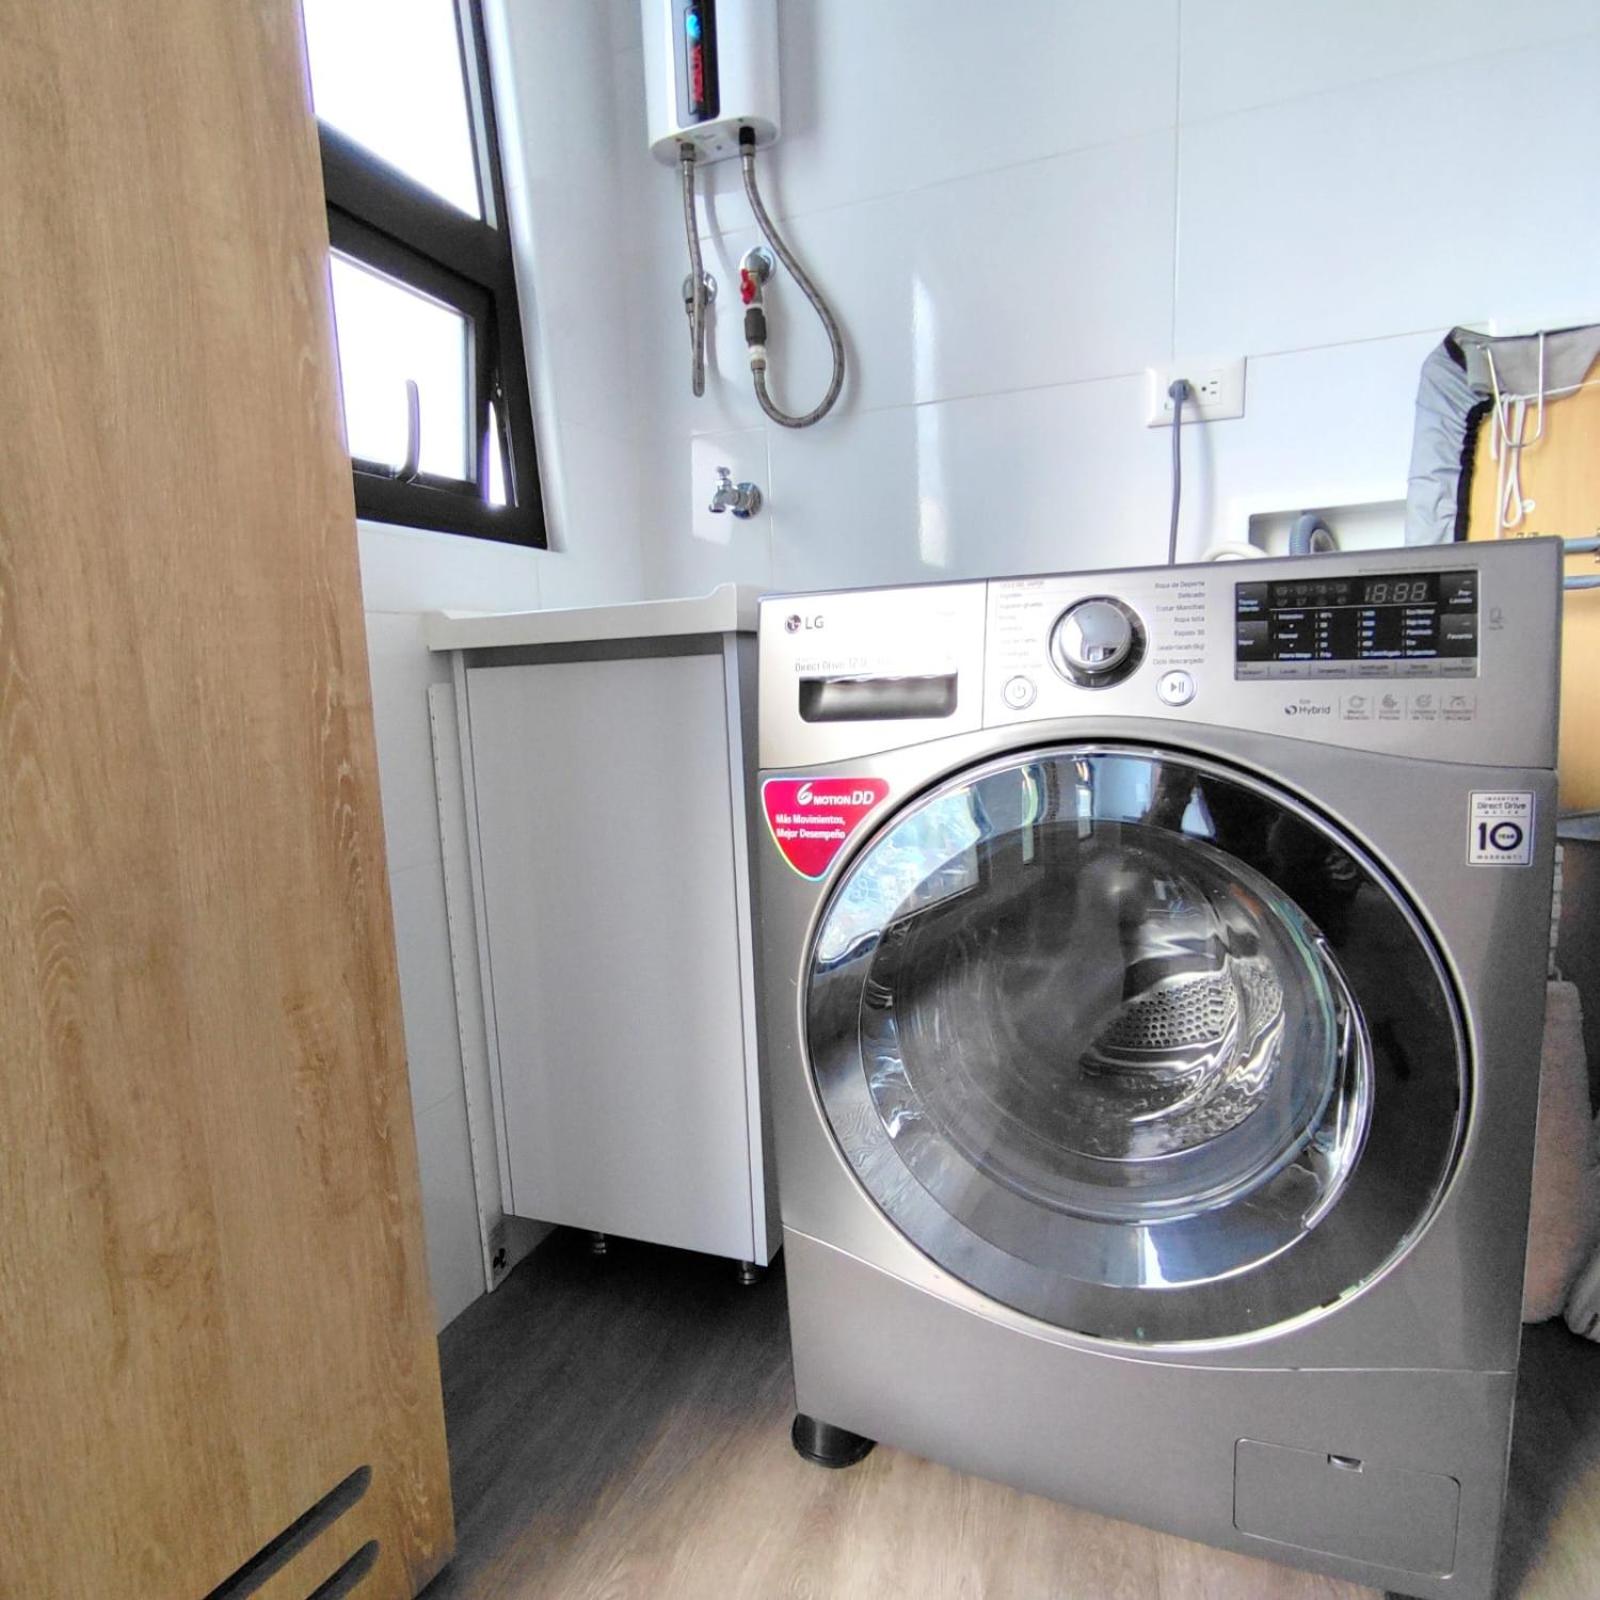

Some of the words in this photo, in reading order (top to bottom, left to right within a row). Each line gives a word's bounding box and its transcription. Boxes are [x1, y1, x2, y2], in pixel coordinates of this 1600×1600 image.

[804, 615, 825, 630] LG
[1299, 704, 1331, 715] Hybrid
[797, 782, 814, 805] 6
[1477, 802, 1502, 810] Direct
[1504, 802, 1527, 810] Drive
[776, 813, 792, 824] Más
[793, 813, 846, 825] Movimientos,
[776, 827, 798, 840] Mejor
[800, 828, 846, 841] Desempeño
[1478, 822, 1524, 851] 10
